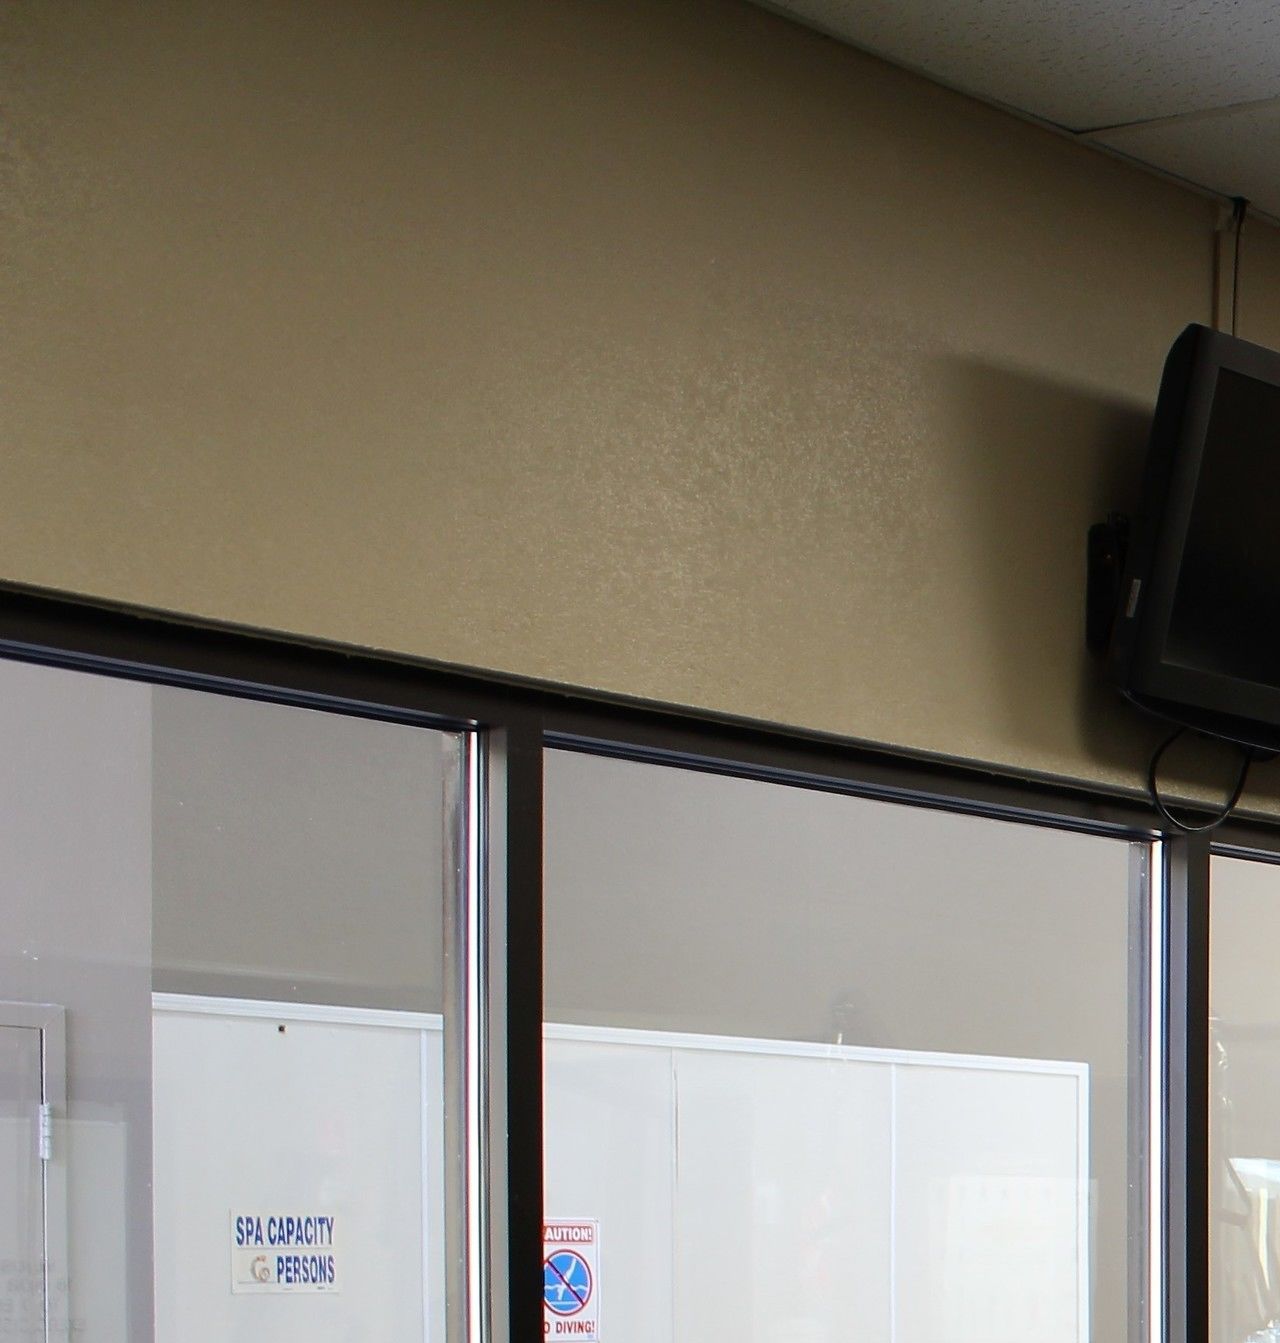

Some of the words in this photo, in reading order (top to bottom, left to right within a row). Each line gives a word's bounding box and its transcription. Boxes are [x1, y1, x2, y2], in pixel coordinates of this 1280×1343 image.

[236, 1216, 264, 1245] SPA
[267, 1216, 334, 1245] CAPACITY
[544, 1227, 592, 1241] AUTION!
[276, 1255, 335, 1284] PERSONS
[555, 1321, 595, 1334] DIVING!
